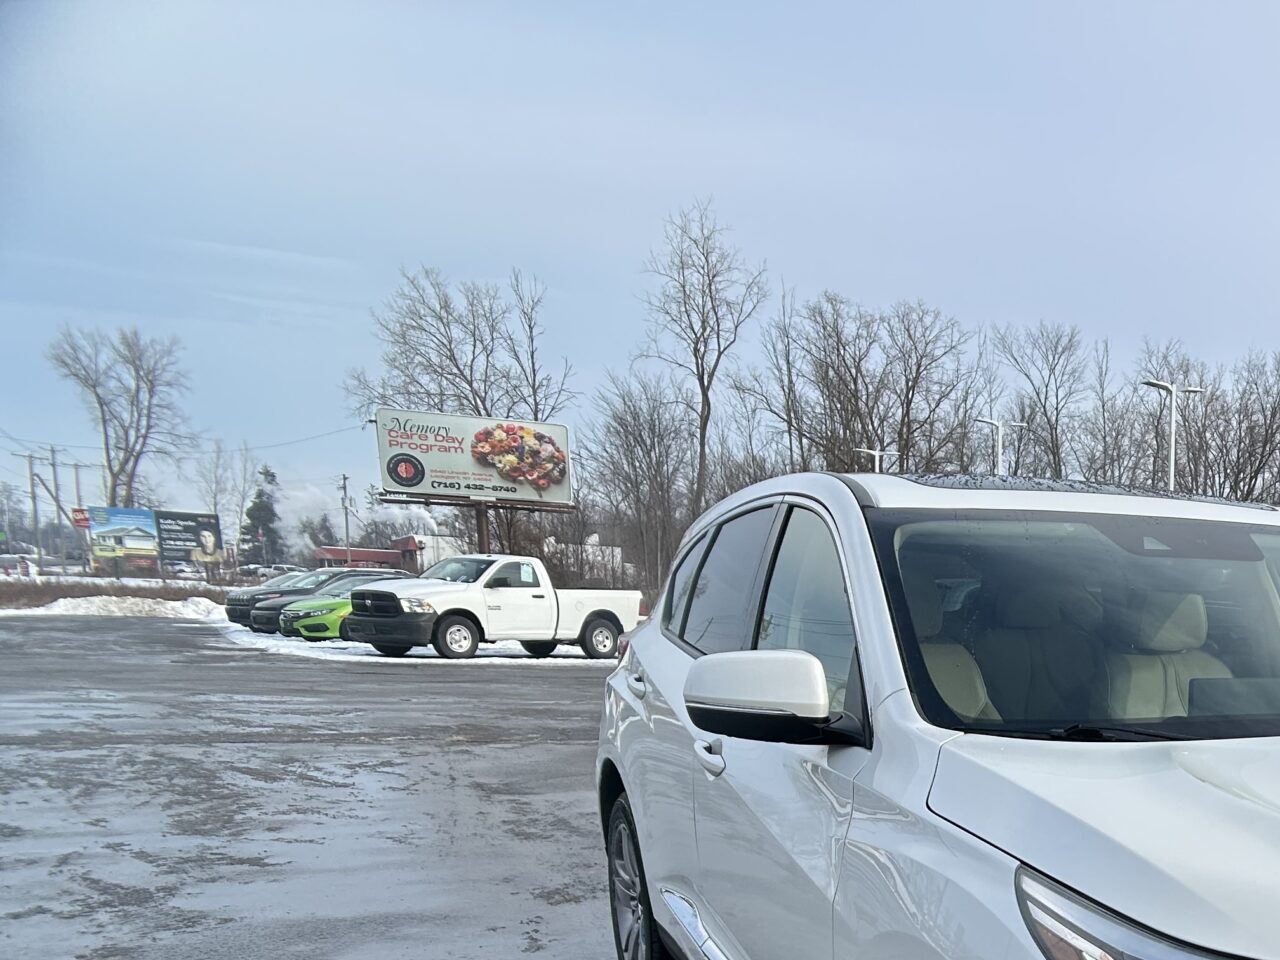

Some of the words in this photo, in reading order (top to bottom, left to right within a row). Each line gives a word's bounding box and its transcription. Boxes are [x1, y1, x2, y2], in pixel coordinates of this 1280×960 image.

[382, 417, 450, 437] Memory
[388, 430, 428, 441] Care
[434, 433, 464, 447] Day
[388, 440, 464, 453] Program
[431, 480, 460, 490] (716)
